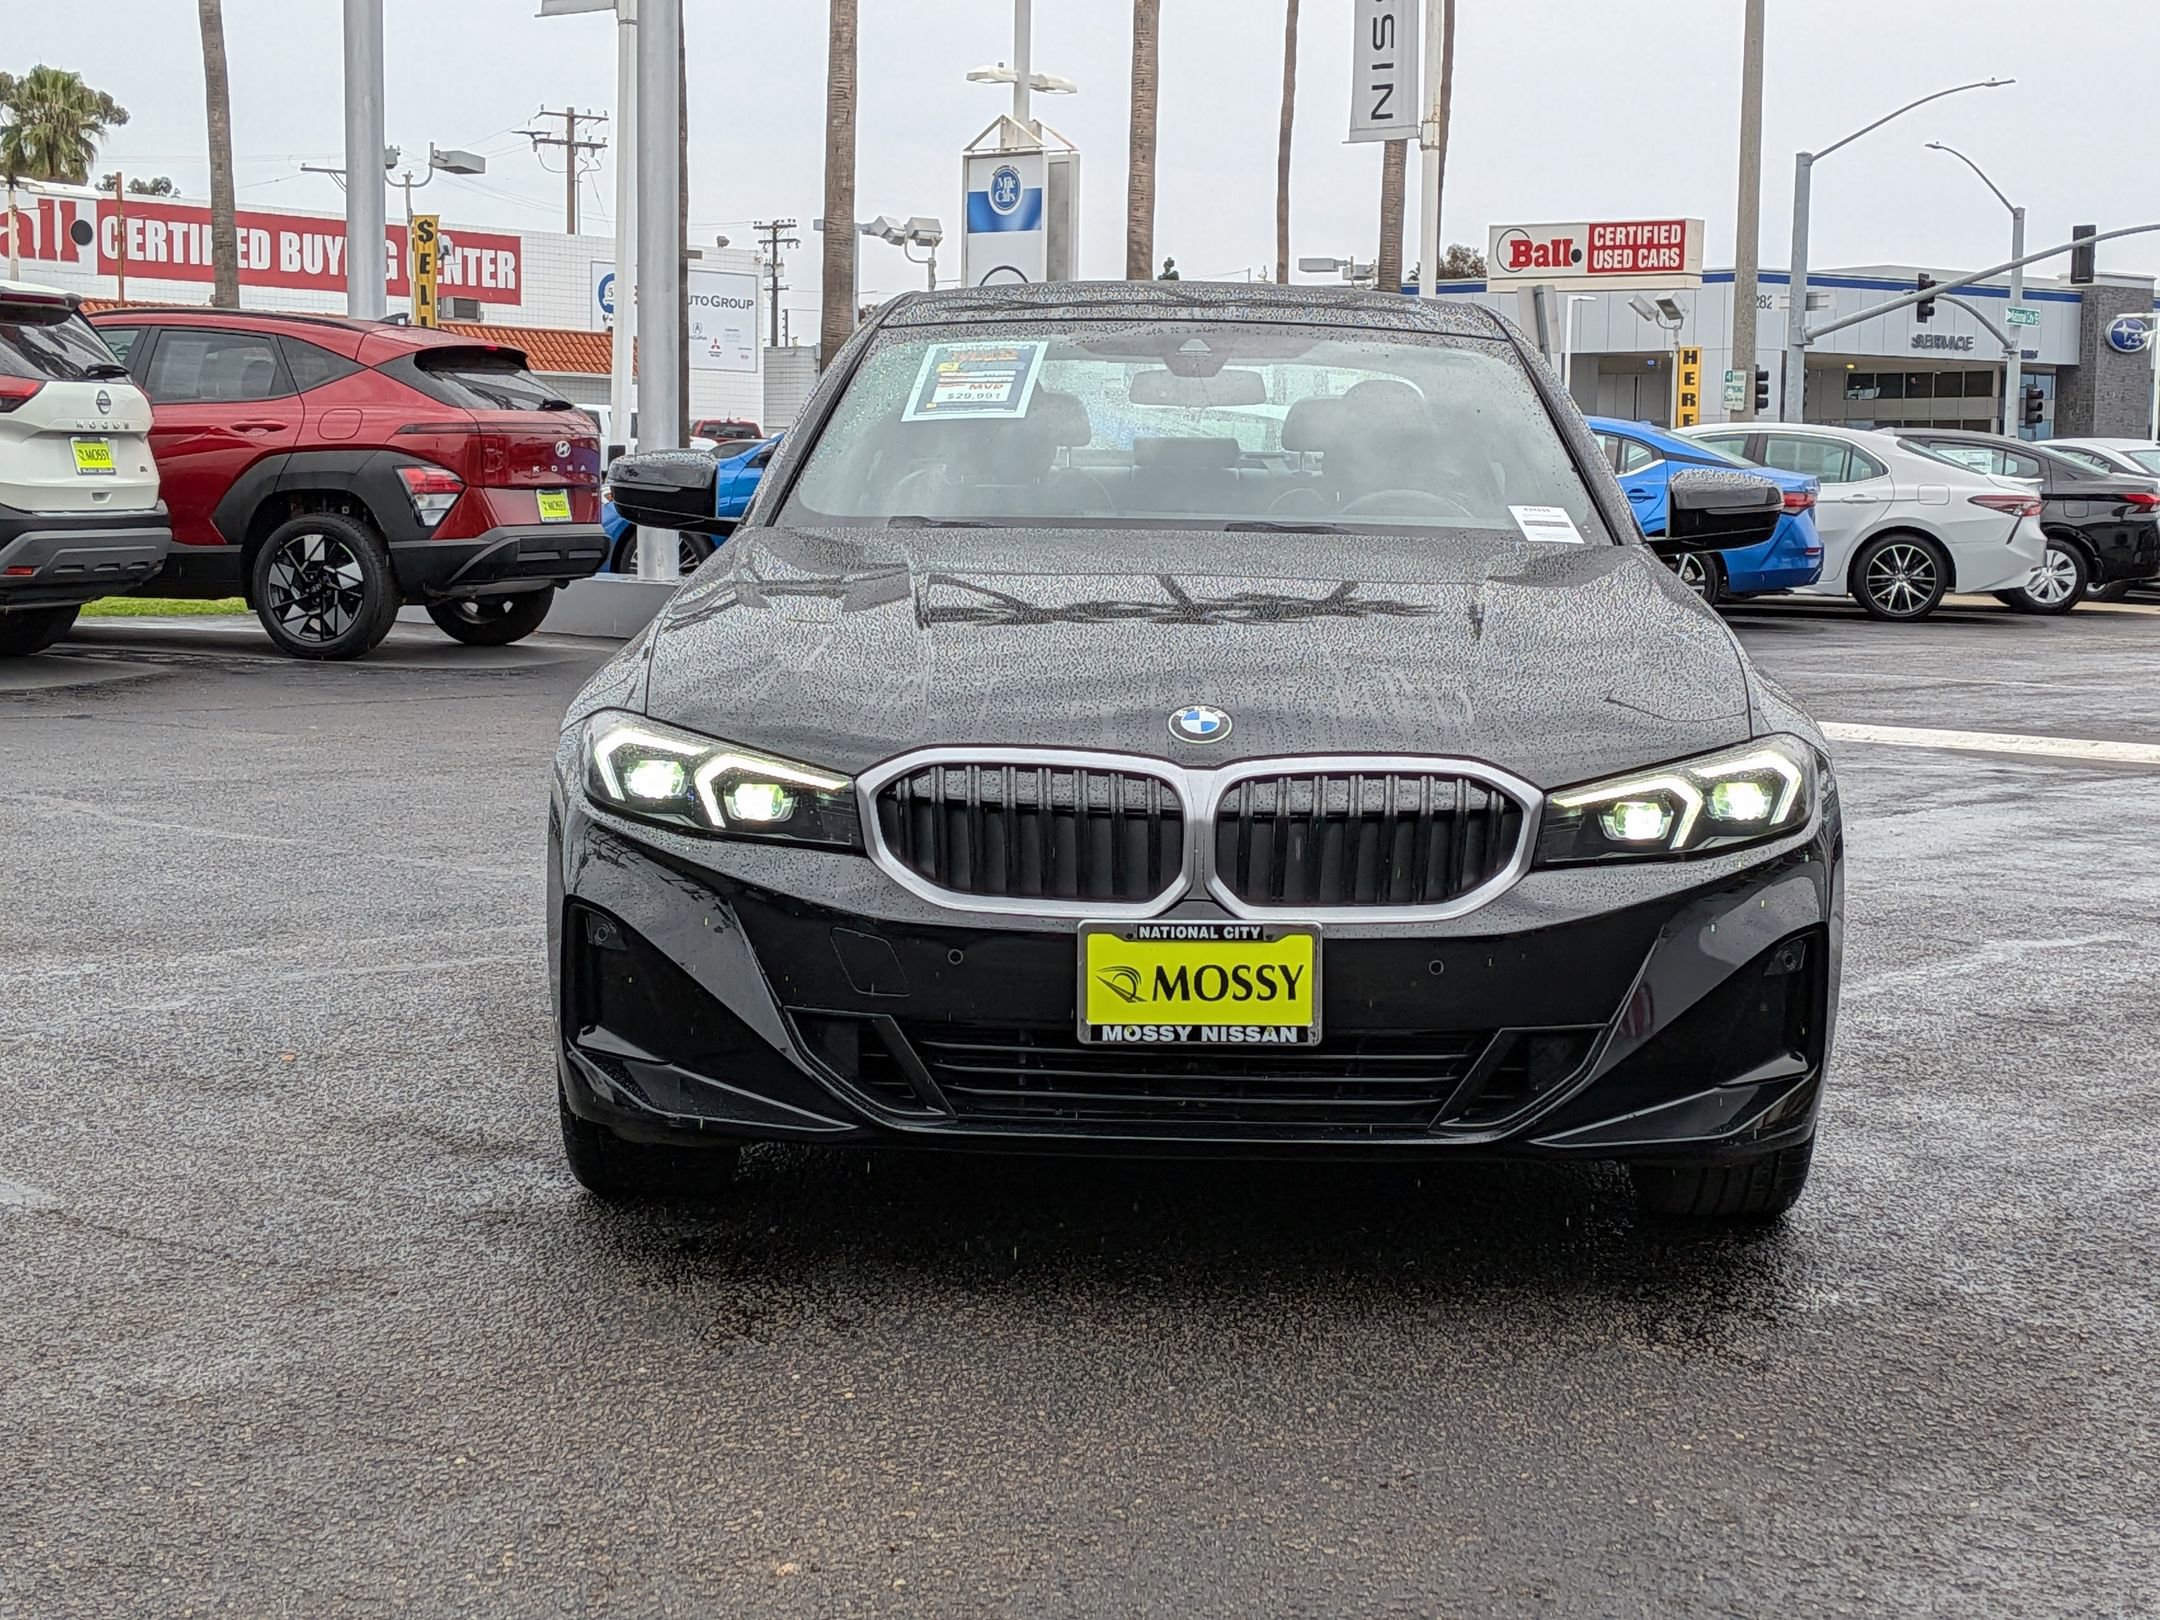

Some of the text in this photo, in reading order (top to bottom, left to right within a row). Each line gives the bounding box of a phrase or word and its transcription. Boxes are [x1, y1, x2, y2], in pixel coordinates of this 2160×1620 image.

[1371, 0, 1394, 120] NIS
[1593, 224, 1681, 247] CERTIFIED
[280, 231, 398, 281] BUYG
[1509, 238, 1574, 268] Ball
[1593, 247, 1680, 269] USED CARS
[710, 295, 754, 310] GROUP
[1911, 334, 1974, 351] SERVICE
[1681, 350, 1698, 426] HERE
[532, 464, 587, 472] KONA
[1139, 926, 1262, 940] NATIONAL CITY
[1152, 964, 1304, 1002] MOSSY
[1102, 1025, 1298, 1043] MOSSY NISSAN
